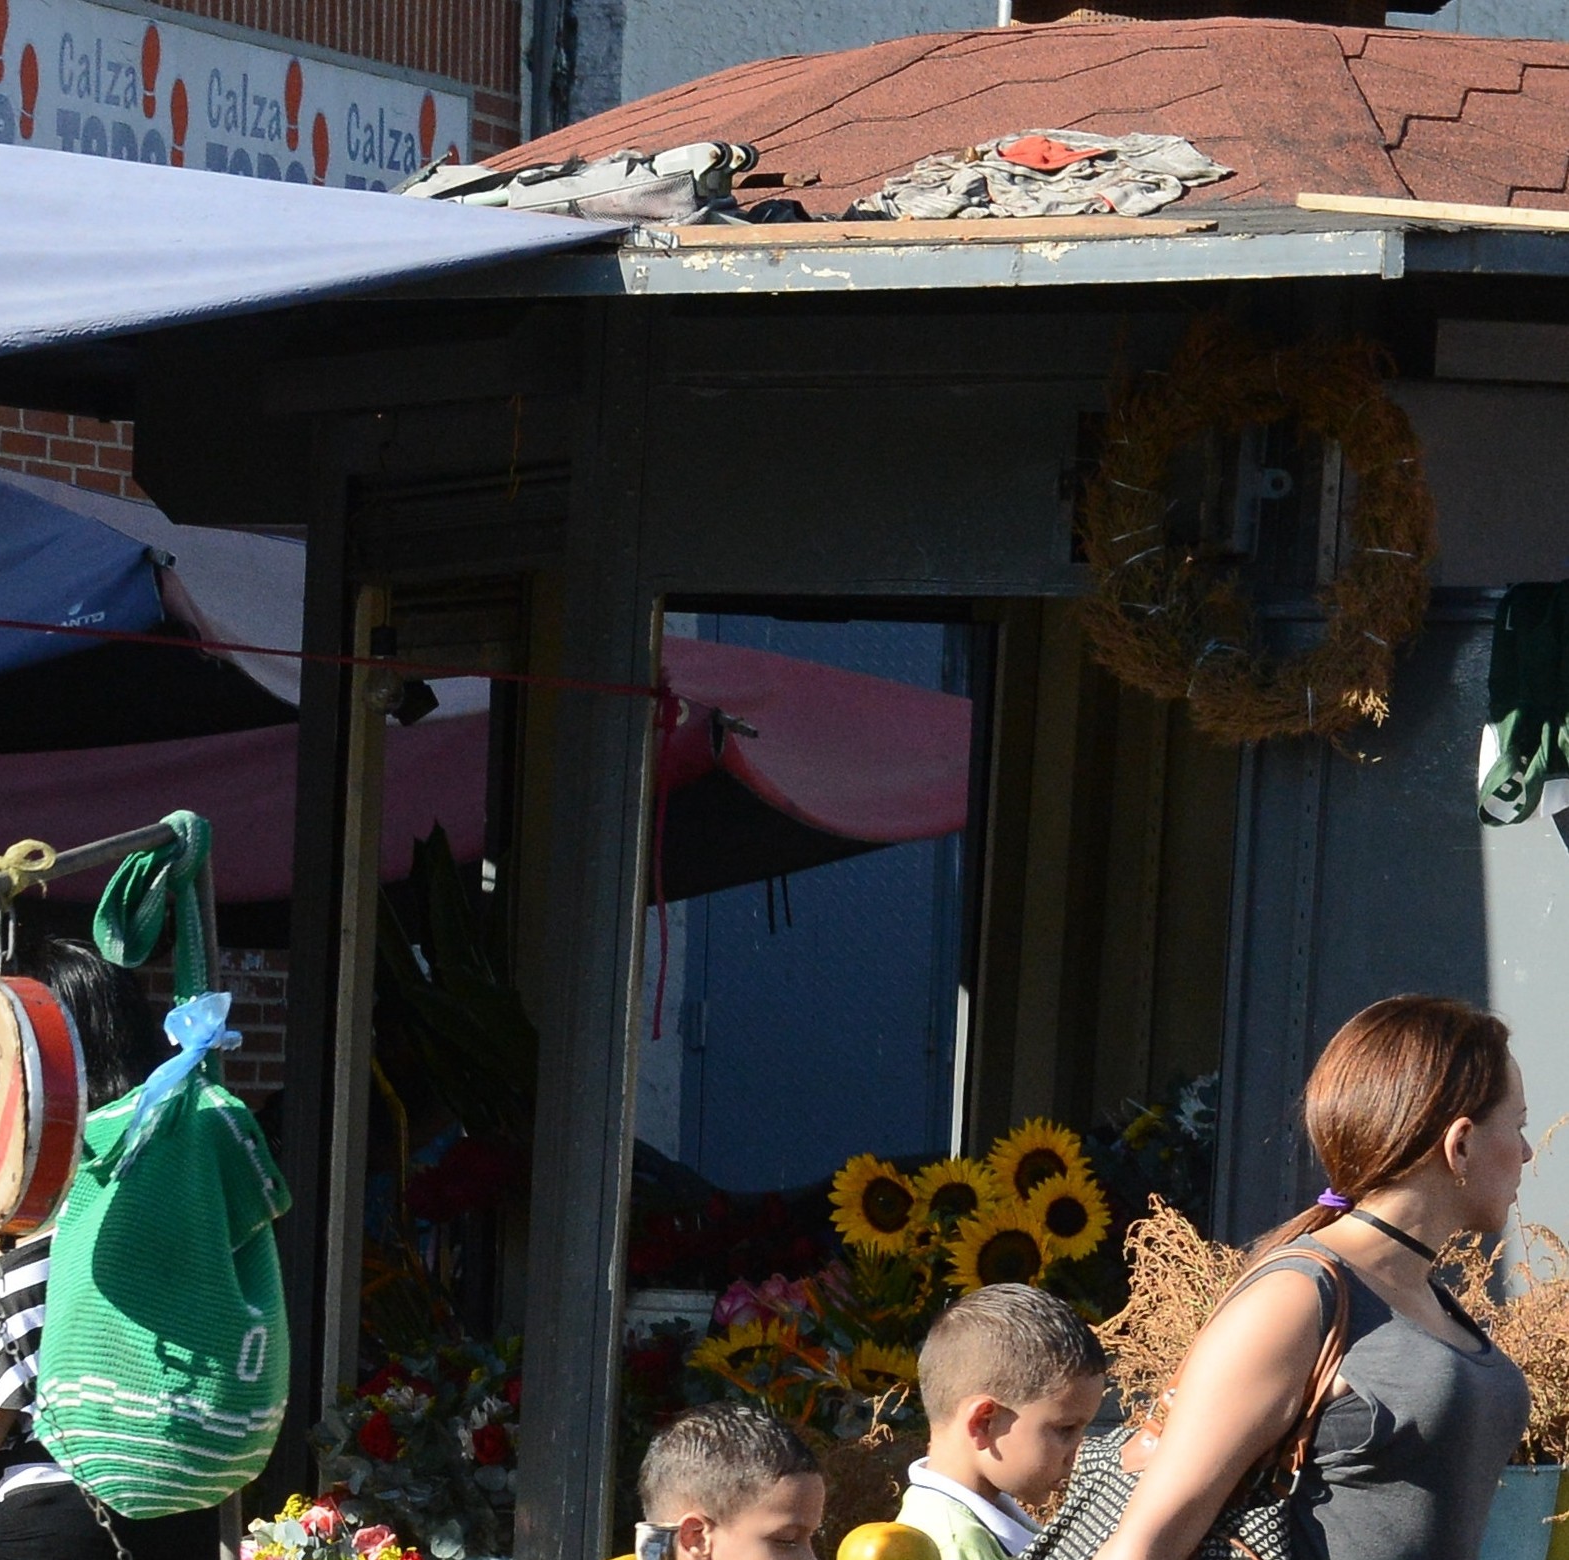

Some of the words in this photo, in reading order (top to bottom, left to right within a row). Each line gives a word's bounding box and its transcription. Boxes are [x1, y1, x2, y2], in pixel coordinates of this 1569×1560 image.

[59, 32, 138, 109] Calza
[208, 68, 282, 142] Calza
[346, 102, 417, 175] Calza
